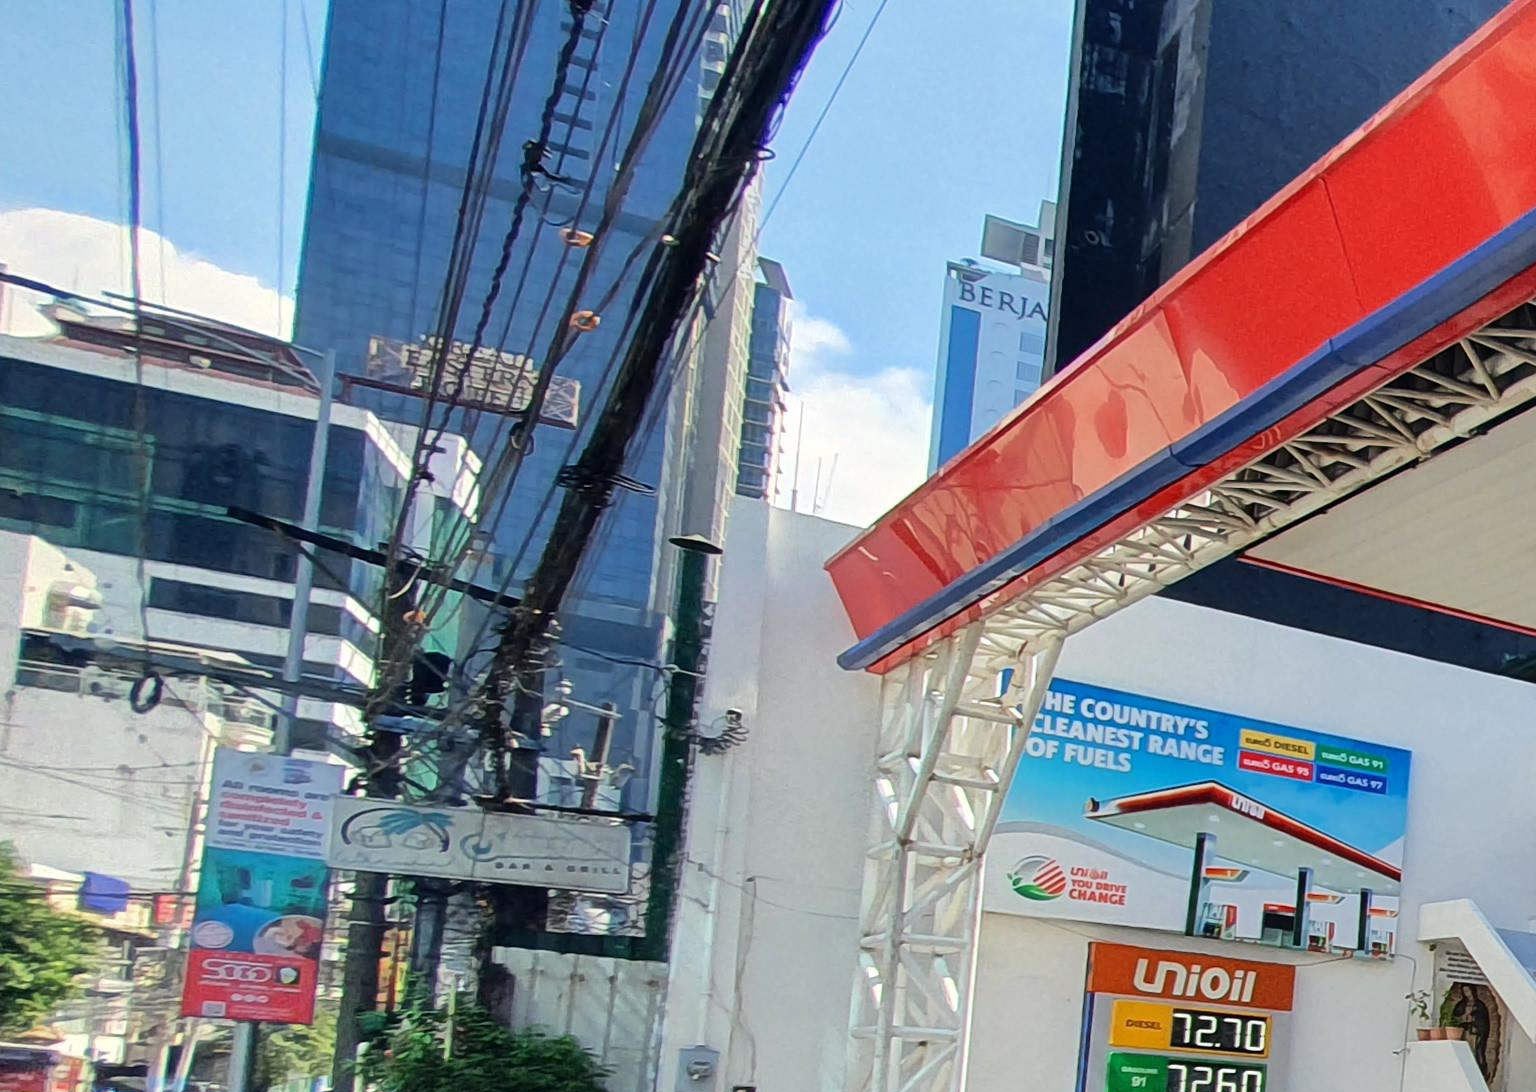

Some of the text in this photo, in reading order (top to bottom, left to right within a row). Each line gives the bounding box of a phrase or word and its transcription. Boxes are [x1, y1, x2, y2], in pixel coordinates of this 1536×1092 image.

[1045, 691, 1209, 739] HE COUNTRY'S
[1031, 713, 1225, 766] CLEANEST RANGE
[1025, 737, 1132, 772] OF FUELS
[1273, 740, 1310, 755] DIESEL
[1349, 753, 1370, 767] GAS
[1371, 758, 1384, 770] 91
[1271, 762, 1295, 774] GAS
[1296, 766, 1310, 777] 95
[1347, 775, 1369, 788] GAS
[1370, 780, 1383, 790] 97
[495, 861, 532, 872] BAR
[567, 865, 622, 876] GRILL
[1070, 879, 1128, 894] YOU DRIVE
[1069, 888, 1126, 906] CHANGE
[1125, 1018, 1162, 1031] DIESEL
[1172, 1012, 1266, 1052] 72.70
[1131, 1075, 1147, 1088] 91
